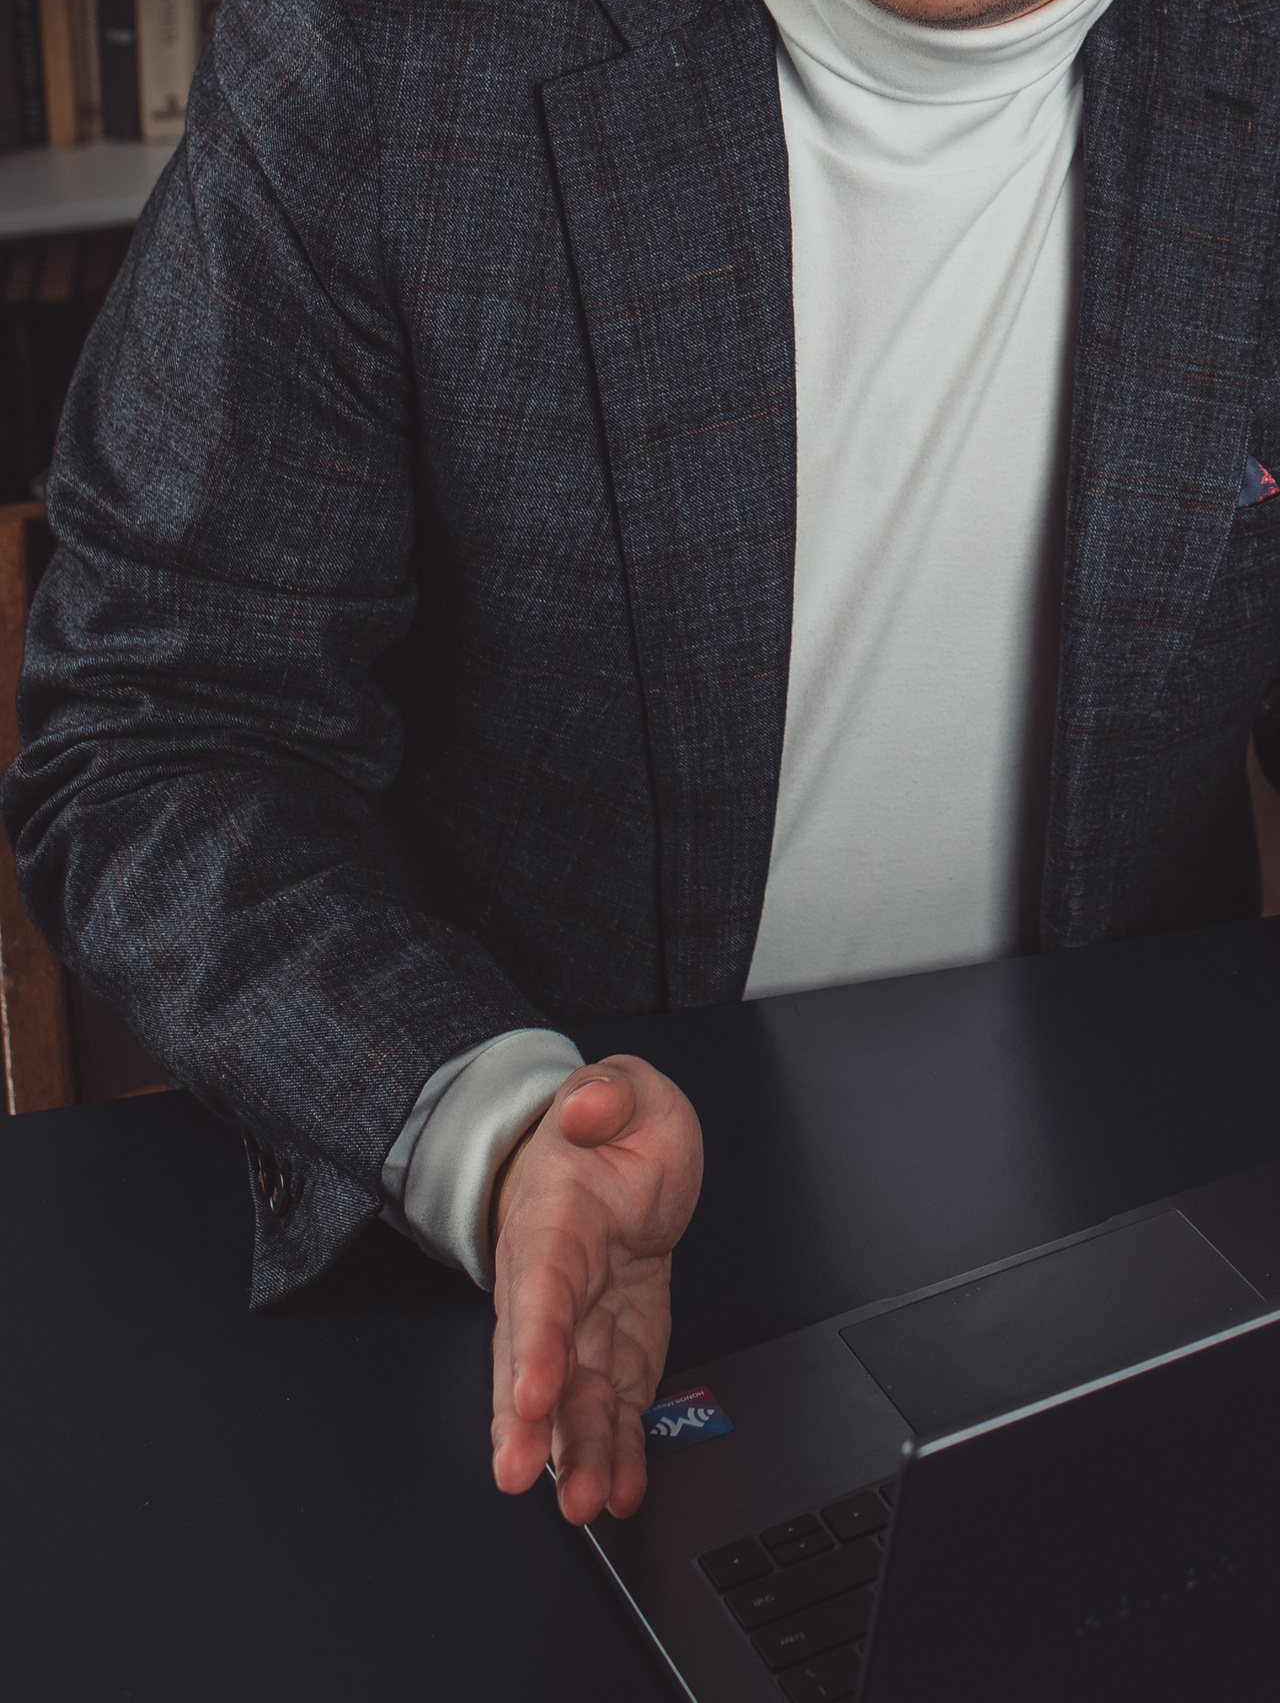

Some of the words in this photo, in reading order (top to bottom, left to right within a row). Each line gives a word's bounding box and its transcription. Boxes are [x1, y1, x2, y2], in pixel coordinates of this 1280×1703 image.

[675, 1390, 705, 1404] HONOR
[751, 1593, 775, 1607] Shift
[780, 1630, 806, 1647] Enter
